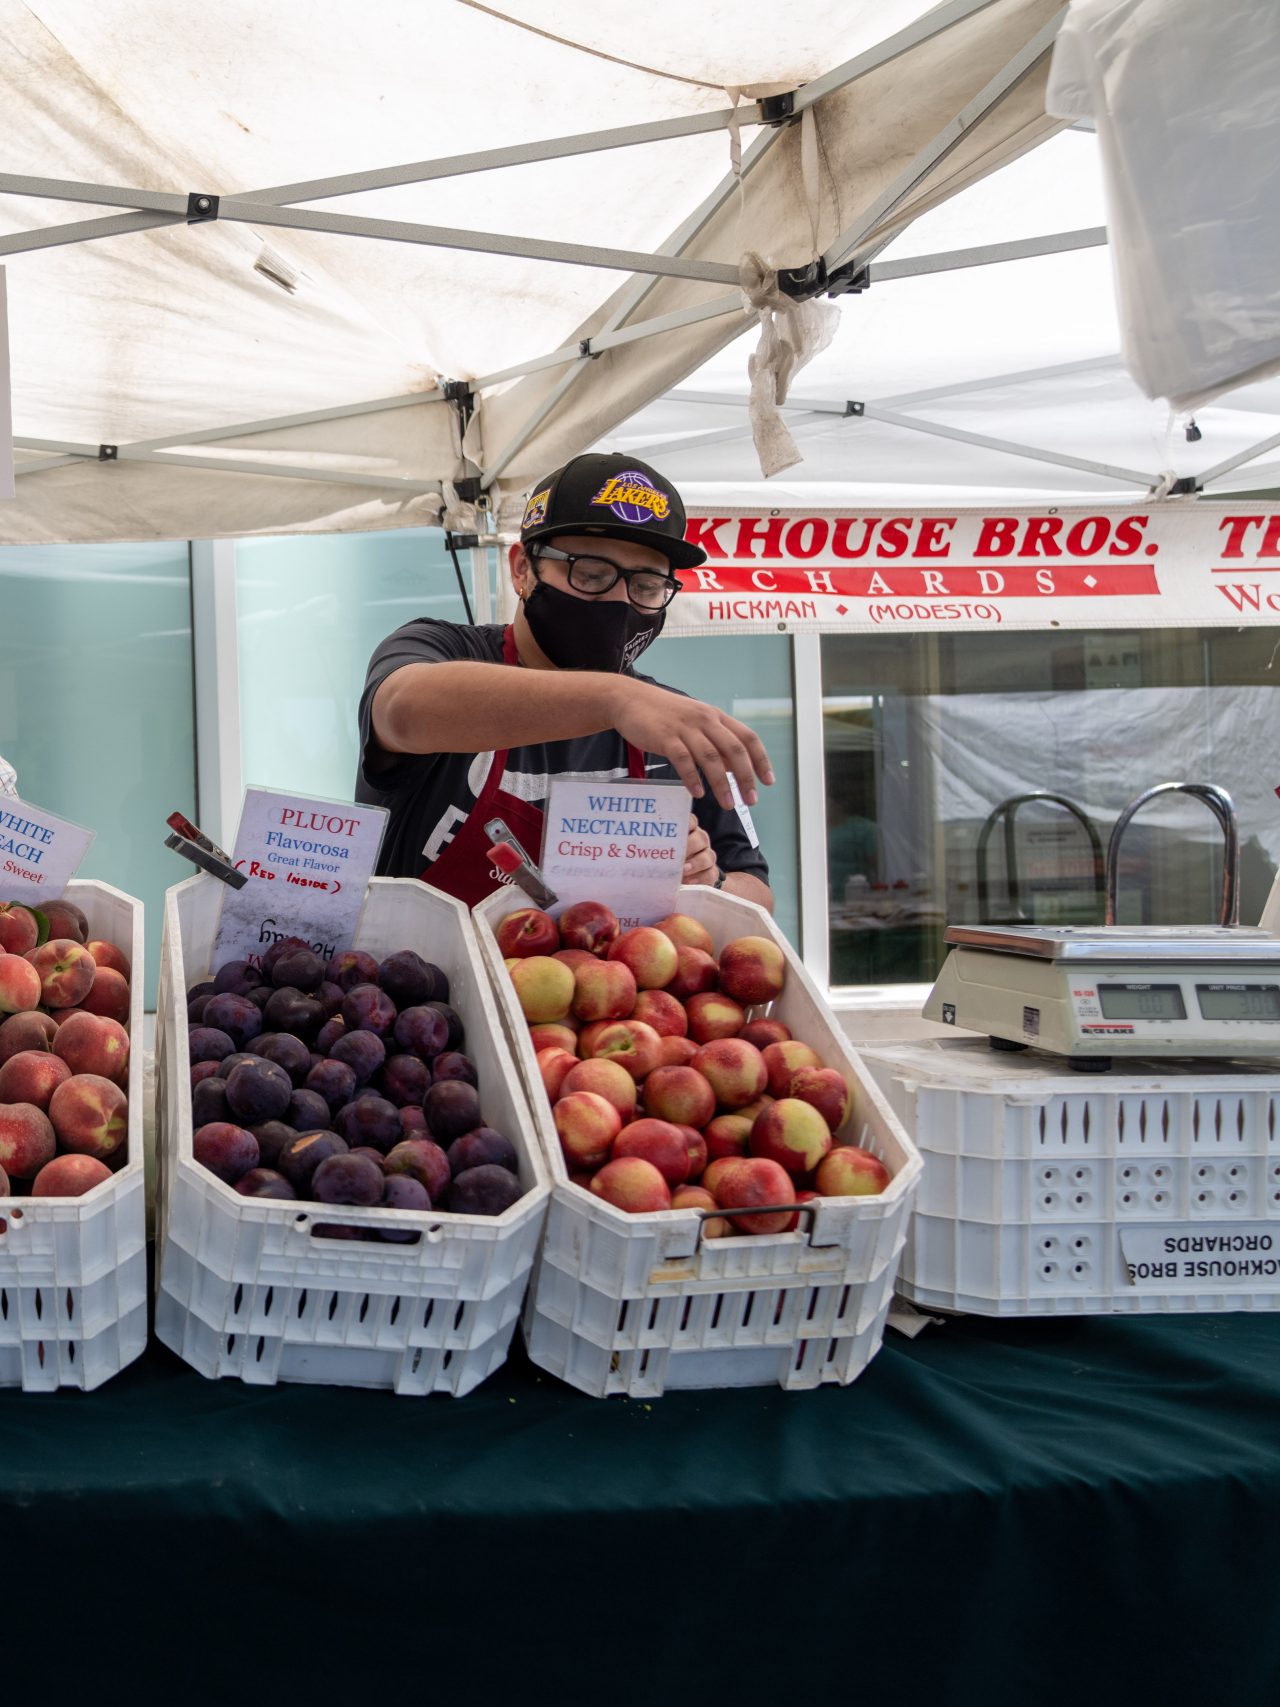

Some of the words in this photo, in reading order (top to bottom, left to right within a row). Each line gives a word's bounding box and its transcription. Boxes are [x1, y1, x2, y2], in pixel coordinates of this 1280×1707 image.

[592, 478, 671, 519] LAKERS
[972, 515, 1159, 557] BROS.
[692, 568, 1056, 597] RCHARDS
[708, 600, 817, 620] HICKMAN
[868, 603, 1003, 624] (MODESTO)
[586, 796, 657, 814] WHITE
[280, 808, 361, 837] PLUOT
[560, 818, 678, 838] NECTARINE
[265, 830, 350, 859] Flavorosa
[558, 841, 604, 861] Crisp
[607, 843, 622, 858] &
[625, 843, 677, 860] Sweet
[3, 860, 45, 884] Sweet
[267, 852, 300, 867] Great
[302, 858, 341, 874] Flavor
[1164, 1235, 1273, 1253] ORCHARDS
[1128, 1262, 1178, 1279] BROS
[1183, 1259, 1280, 1278] CKHOUSE
